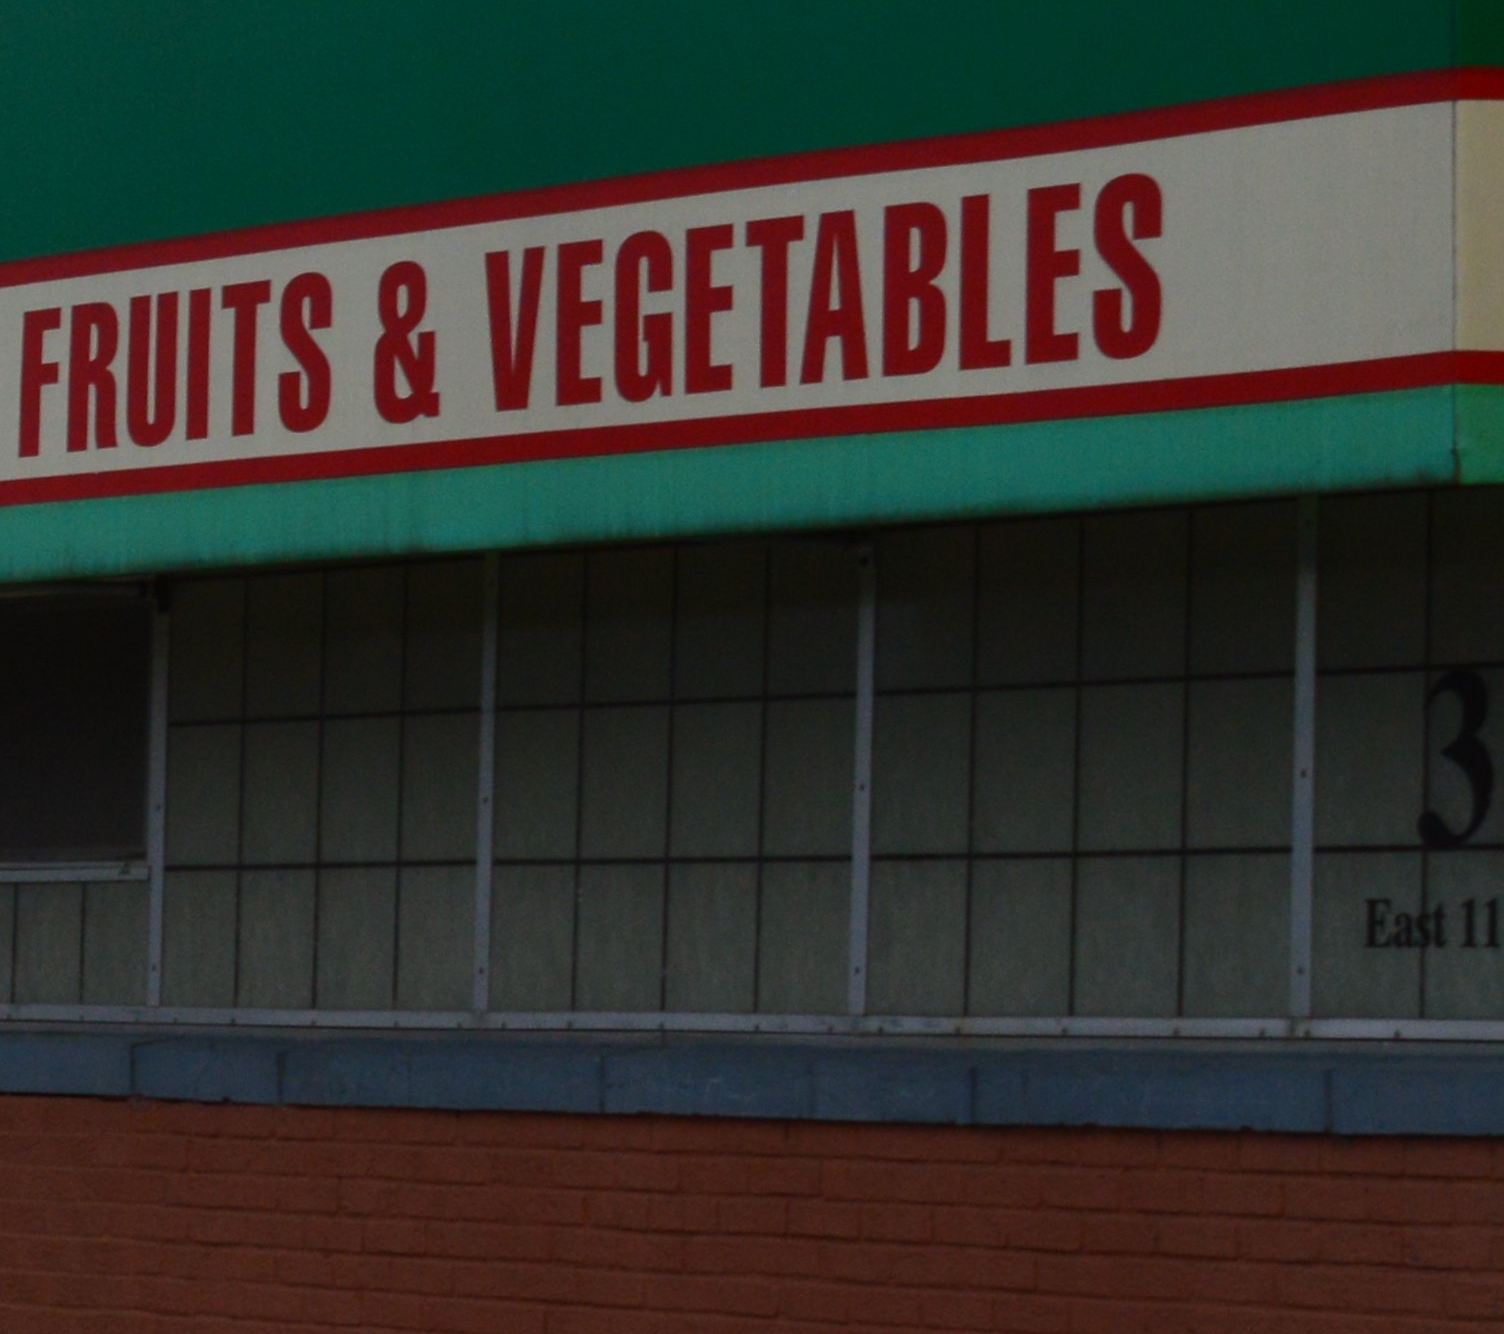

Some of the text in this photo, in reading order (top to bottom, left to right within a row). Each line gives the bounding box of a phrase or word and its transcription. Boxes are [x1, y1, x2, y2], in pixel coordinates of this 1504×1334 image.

[18, 173, 1163, 458] FRUITS & VEGETABLES
[1365, 898, 1446, 948] East
